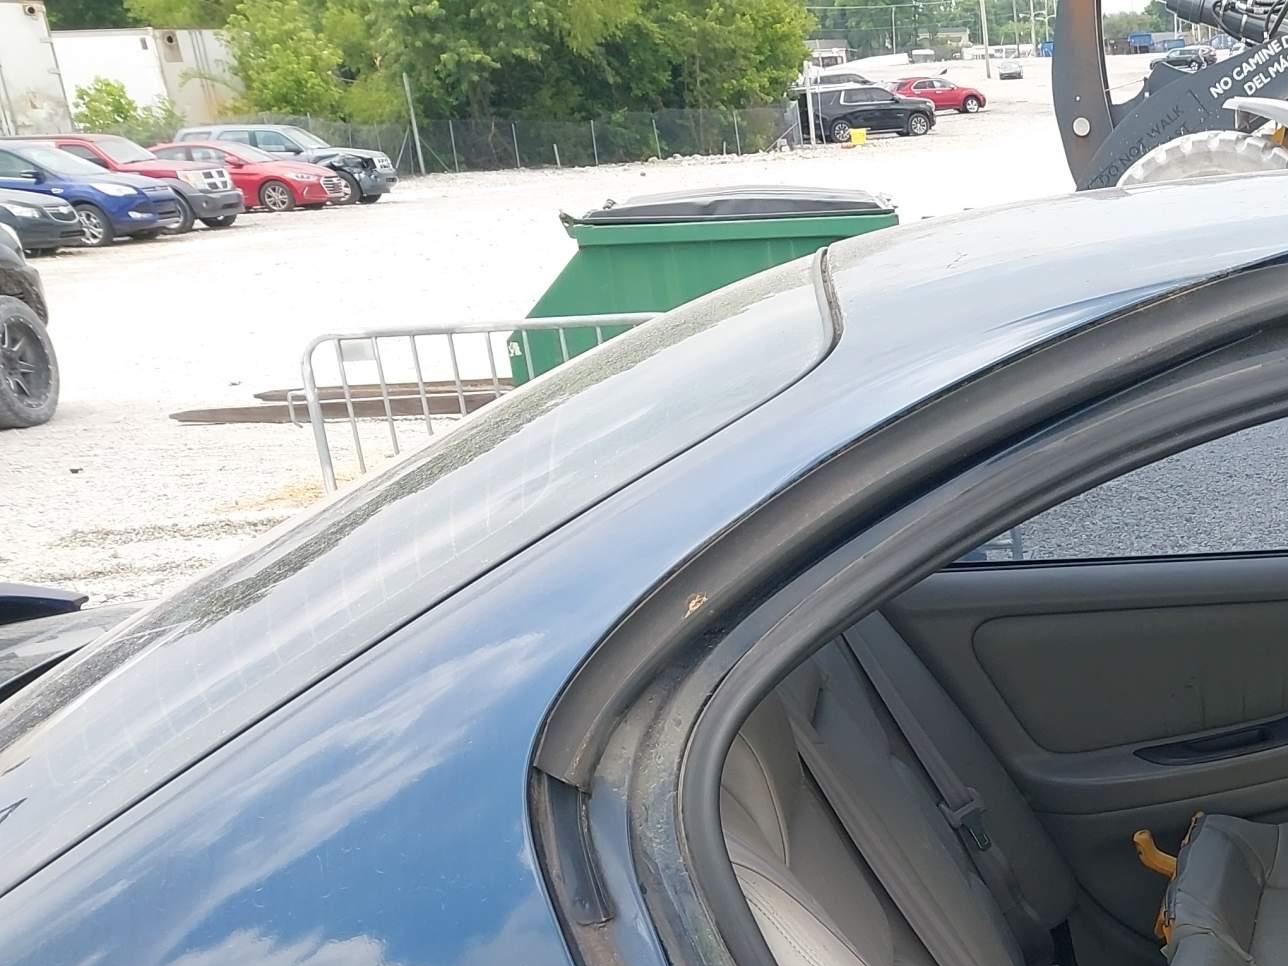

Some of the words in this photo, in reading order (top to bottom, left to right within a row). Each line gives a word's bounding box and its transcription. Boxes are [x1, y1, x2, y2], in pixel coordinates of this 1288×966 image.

[1209, 76, 1232, 98] NO
[1232, 39, 1282, 80] CAMINE
[1243, 72, 1271, 96] DEL
[1119, 138, 1146, 166] NOT
[1146, 105, 1184, 139] WALK
